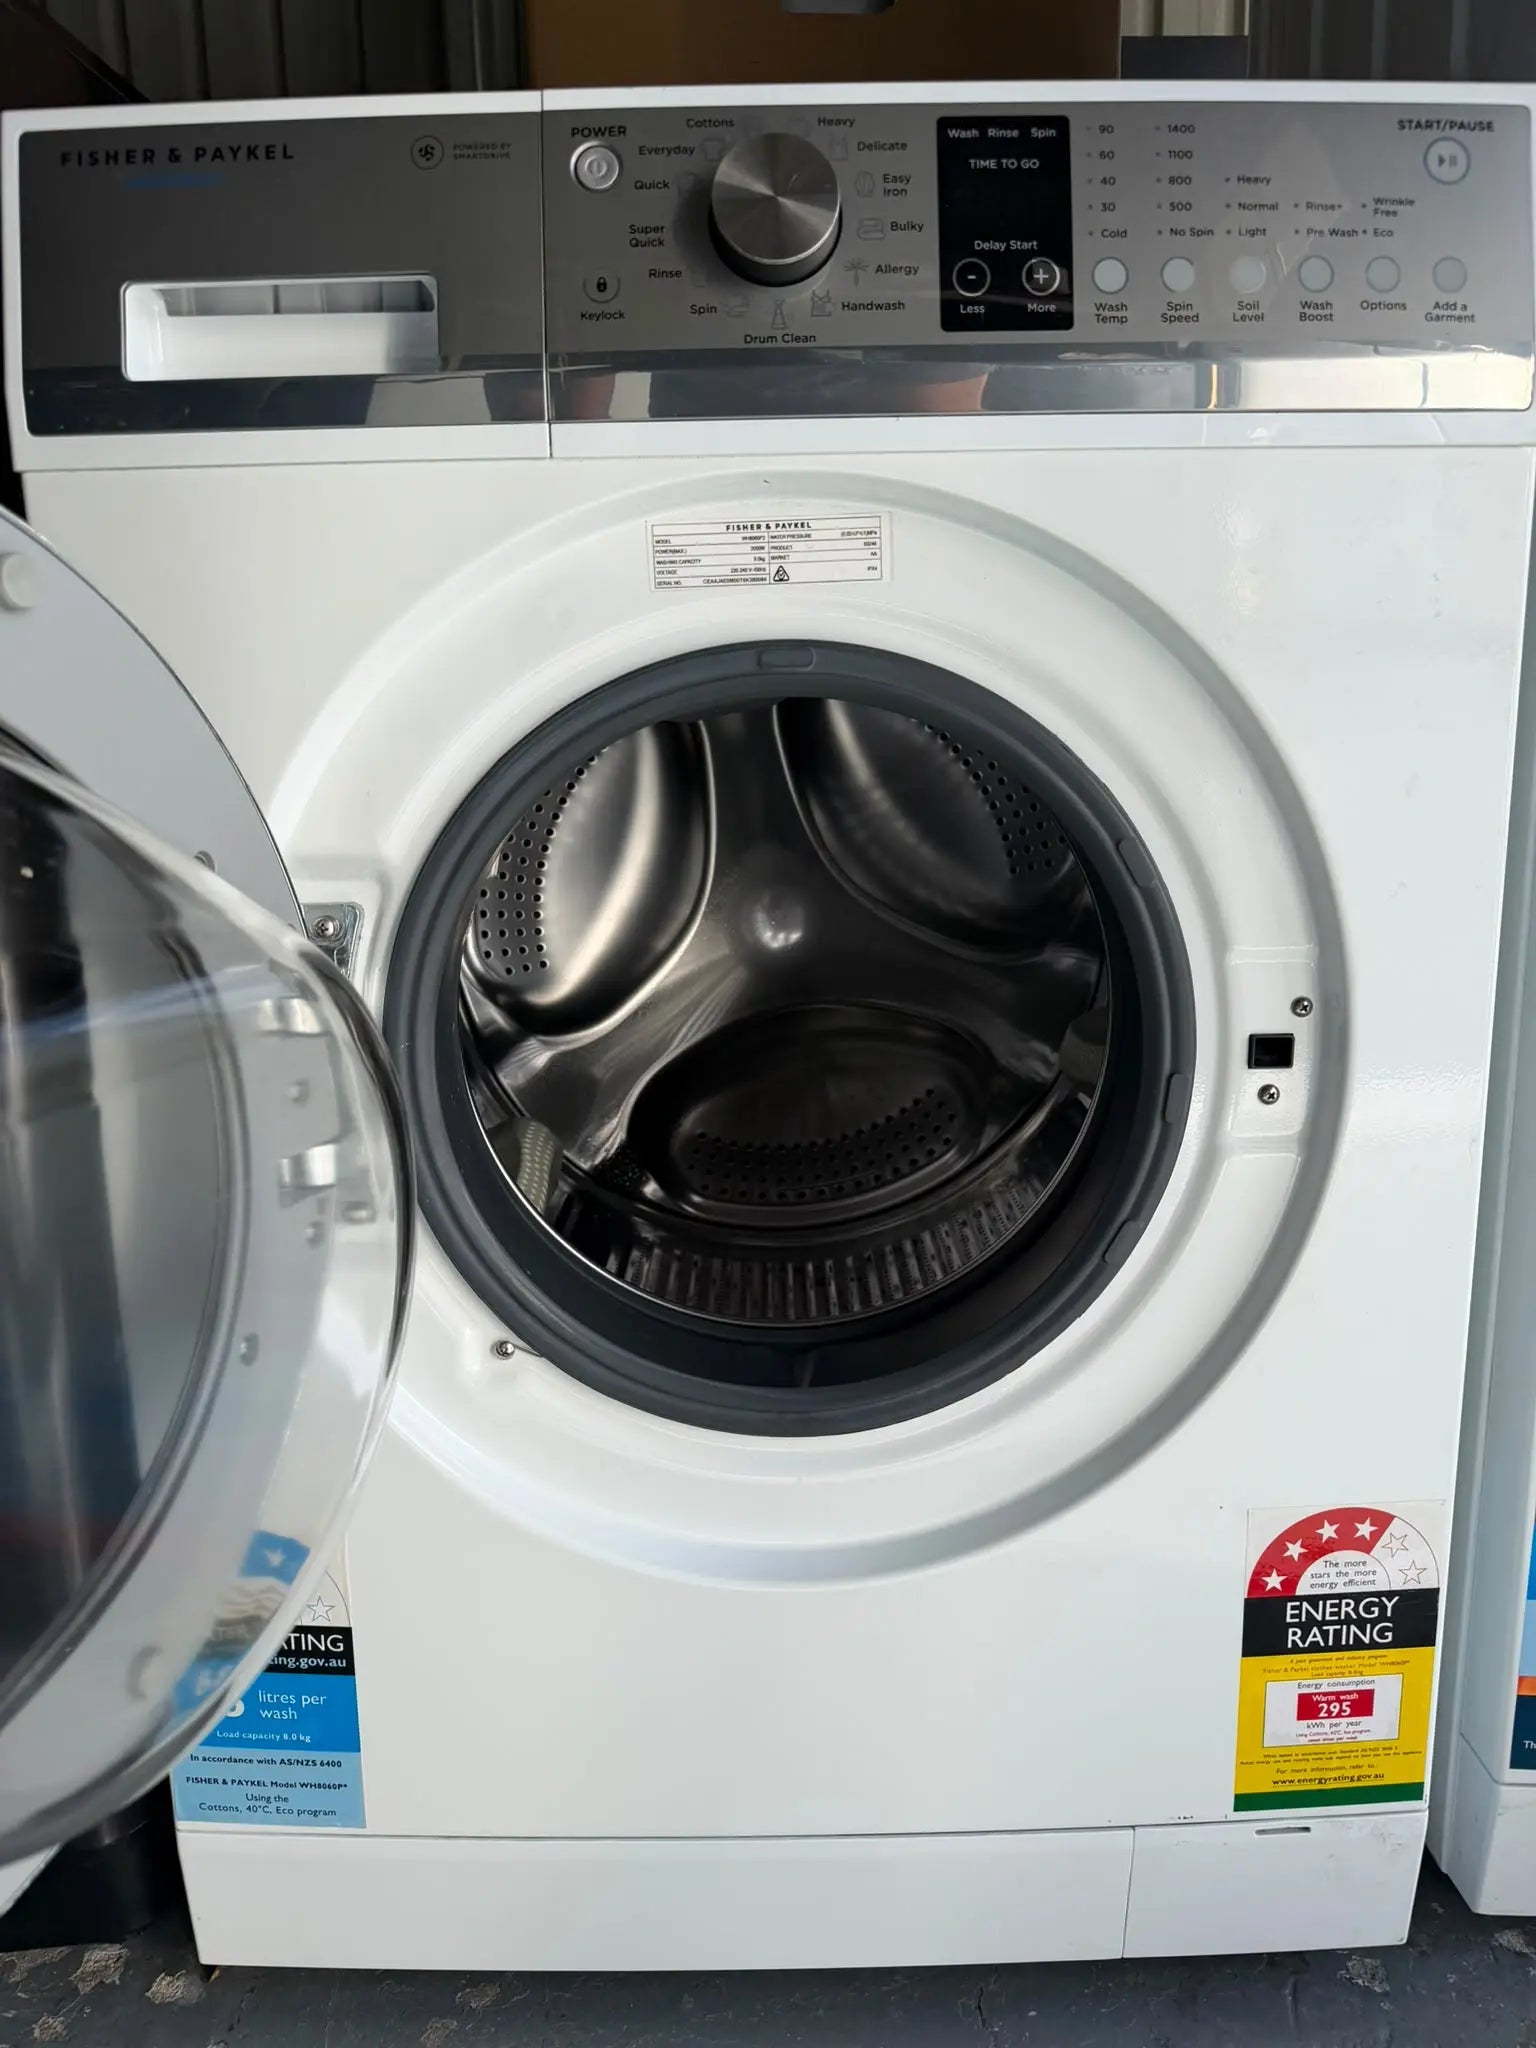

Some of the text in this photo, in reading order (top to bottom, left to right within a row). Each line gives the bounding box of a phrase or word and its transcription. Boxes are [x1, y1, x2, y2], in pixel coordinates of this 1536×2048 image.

[686, 117, 735, 129] Cottons
[817, 116, 855, 128] Heavy
[1397, 120, 1495, 133] START/PAUSE
[570, 125, 627, 138] POWER
[947, 127, 1056, 139] Wash Rinse Spin
[1099, 124, 1114, 134] 90
[1167, 124, 1195, 134] 1400
[638, 144, 696, 157] Everyday
[857, 140, 908, 152] Delicate
[60, 144, 294, 168] FISHER & PAYKEL
[1099, 150, 1115, 160] 60
[1168, 150, 1193, 160] 1100
[968, 159, 1040, 169] TIME TO GO
[634, 179, 670, 191] Quick
[883, 173, 911, 186] Easy
[1100, 176, 1116, 186] 40
[1168, 176, 1192, 186] 800
[1237, 175, 1272, 186] Heavy
[883, 186, 907, 197] Iron
[1100, 202, 1116, 212] 30
[1169, 202, 1192, 212] 500
[1238, 202, 1279, 212] Normal
[1373, 197, 1415, 207] Wrinkle
[1374, 208, 1398, 218] Free
[629, 224, 665, 236] Super
[890, 221, 924, 233] Bulky
[1170, 227, 1214, 238] No Spin
[1238, 227, 1267, 238] Light
[1306, 227, 1358, 238] Pre Wash
[1101, 229, 1128, 239] Cold
[1373, 228, 1394, 238] Eco
[629, 237, 665, 249] Quick
[974, 240, 1038, 251] Delay Start
[648, 268, 682, 279] Rinse
[875, 263, 920, 276] Allergy
[690, 304, 717, 315] Spin
[841, 300, 905, 312] Handwash
[960, 304, 985, 314] Less
[1027, 303, 1056, 313] More
[1094, 302, 1128, 313] Wash
[1166, 301, 1193, 313] Spin
[1237, 301, 1260, 312] Soil
[1300, 300, 1333, 311] Wash
[1360, 300, 1407, 312] Options
[1432, 301, 1468, 312] Add a
[580, 310, 625, 322] Keylock
[1095, 314, 1128, 325] Temp
[1160, 313, 1200, 324] Speed
[1232, 312, 1264, 323] Level
[1299, 312, 1334, 323] Boost
[1424, 312, 1476, 323] Garment
[744, 333, 816, 345] Drum Clean
[775, 522, 812, 530] PAYKEL
[1323, 1560, 1367, 1569] The more
[1310, 1569, 1377, 1579] stars the more
[1310, 1578, 1376, 1590] energy efficient
[1285, 1596, 1400, 1623] ENERGY
[1287, 1623, 1394, 1649] RATING
[281, 1633, 344, 1652] TING
[1297, 1678, 1376, 1690] Energy consumption
[258, 1690, 327, 1708] litres per
[1312, 1692, 1359, 1702] Warm wash
[259, 1707, 297, 1720] wash
[1317, 1701, 1352, 1718] 295
[1306, 1720, 1363, 1730] kWh per year
[216, 1730, 311, 1743] Load capacity 8.0 kg
[190, 1754, 342, 1768] In accordance with AS/NZS 6400
[1276, 1767, 1288, 1775] For
[186, 1776, 220, 1786] FISHER
[221, 1778, 228, 1786] &
[231, 1778, 269, 1788] PAYKEL
[270, 1780, 297, 1789] Model
[1272, 1773, 1385, 1786] www.energyrating.gov.au
[245, 1793, 289, 1804] Using the
[199, 1802, 337, 1818] Cottons, 40°C, Eco program
